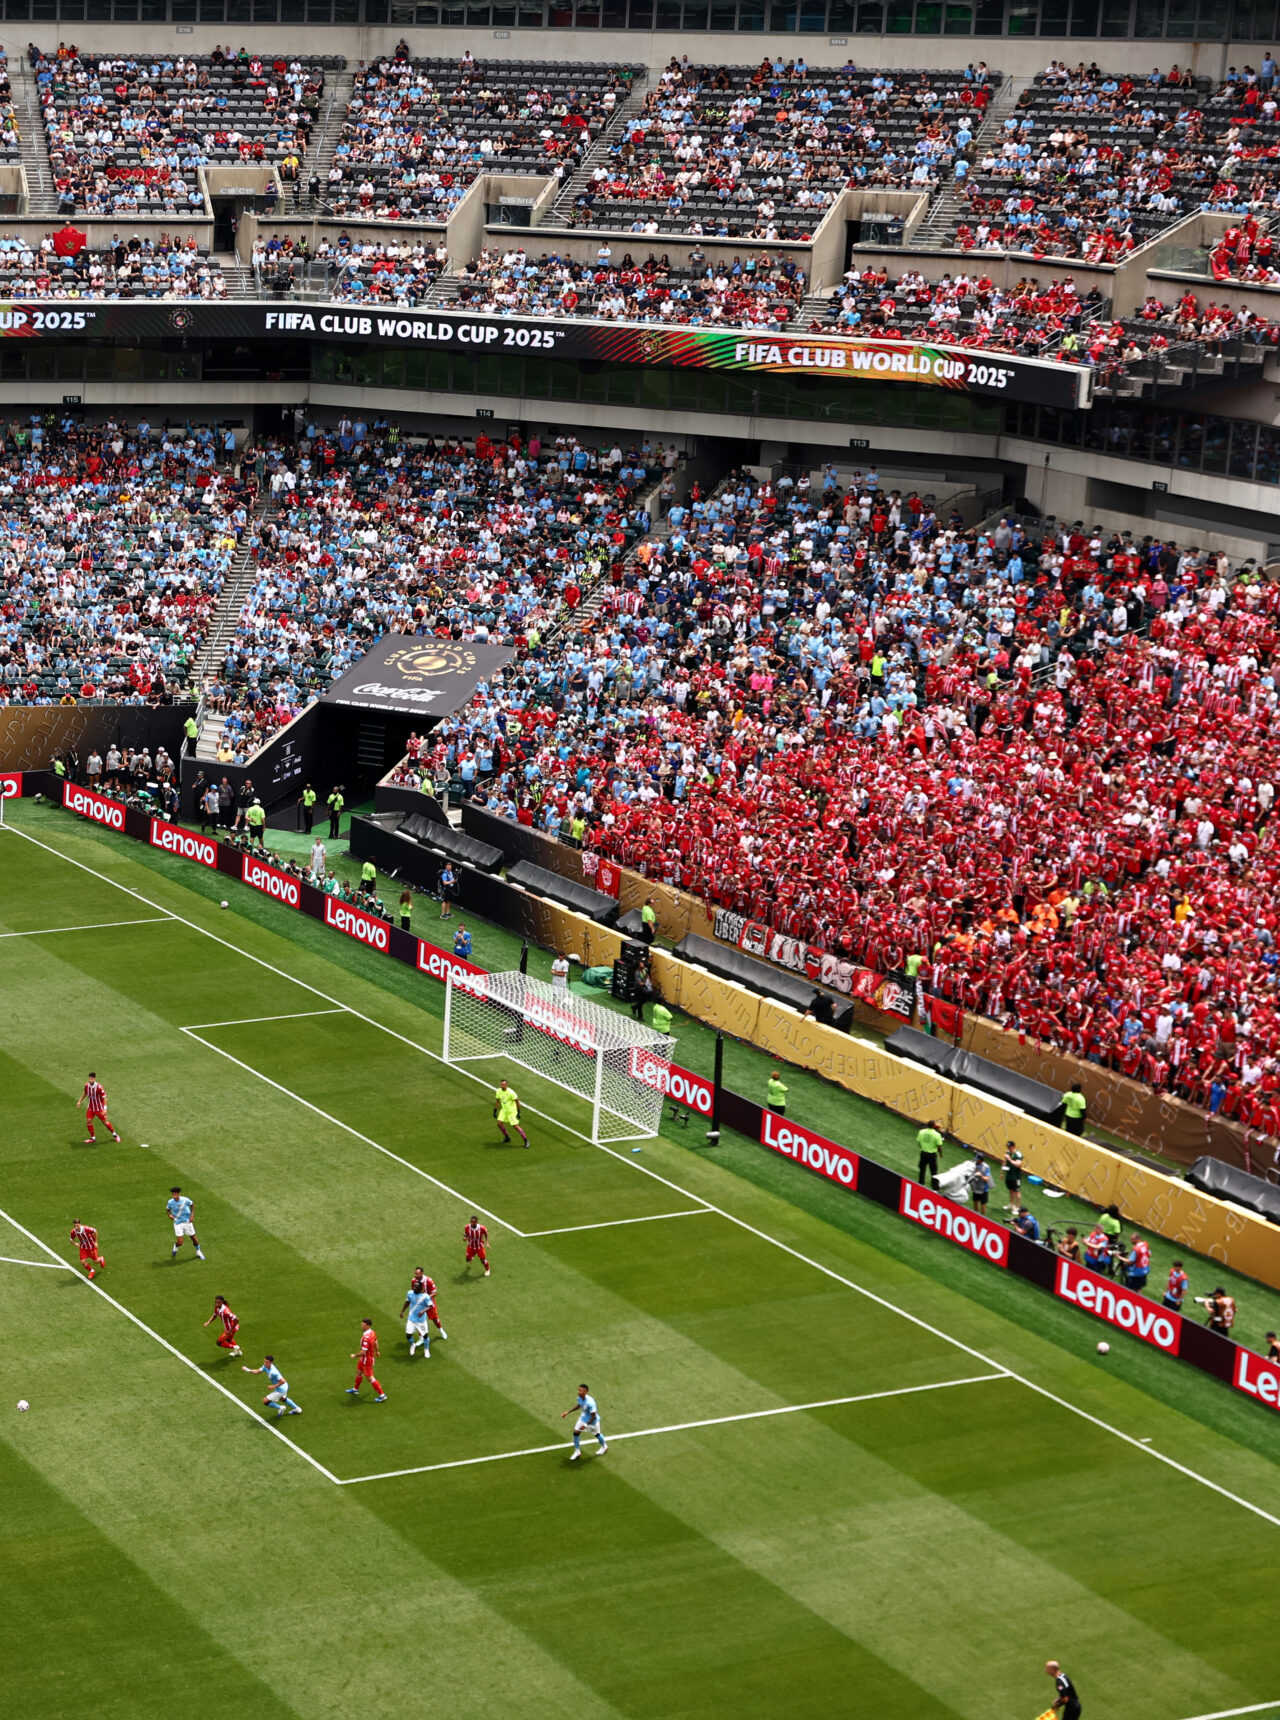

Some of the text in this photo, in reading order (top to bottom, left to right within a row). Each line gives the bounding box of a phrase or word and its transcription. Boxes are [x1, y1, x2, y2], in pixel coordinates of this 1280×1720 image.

[320, 314, 371, 334] CLUB
[378, 318, 453, 341] WORLD
[457, 324, 499, 344] CUP
[734, 343, 782, 364] FIFA
[788, 347, 846, 369] CLUB
[852, 351, 930, 375] WORLD
[933, 358, 964, 380] CUP
[384, 650, 407, 666] CLUB
[412, 643, 463, 652] WORLD
[464, 652, 476, 665] CUP
[353, 683, 447, 703] Coca-Cola
[67, 785, 123, 827] Lenovo
[153, 821, 215, 864] Lenovo
[245, 858, 298, 904] Lenovo
[328, 899, 386, 948] Lenovo
[632, 1048, 711, 1112] Lenovo
[765, 1114, 854, 1183] Lenovo
[905, 1183, 1003, 1259] Lenovo
[1061, 1262, 1174, 1346] Lenovo
[1239, 1353, 1280, 1407] Le
